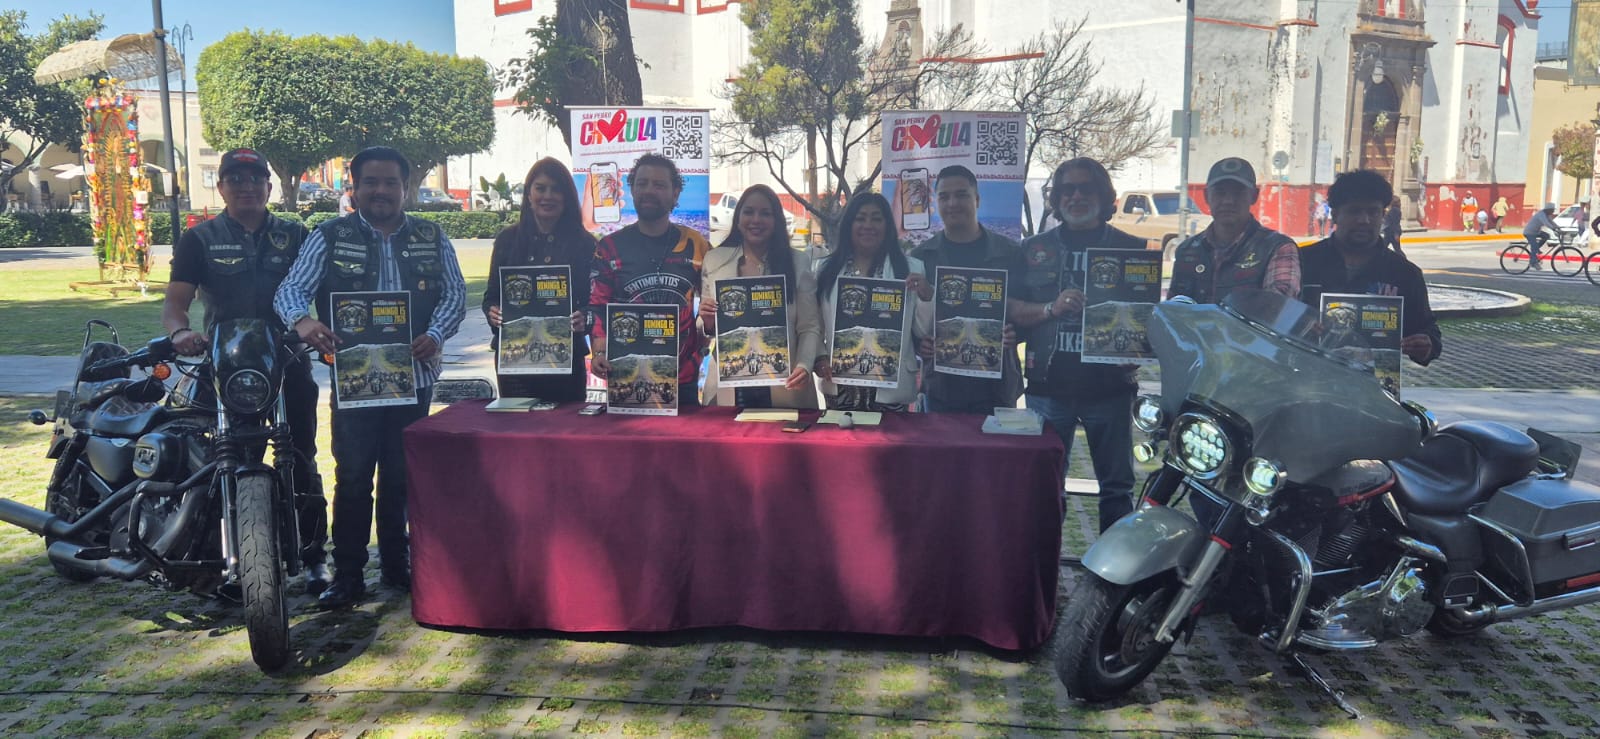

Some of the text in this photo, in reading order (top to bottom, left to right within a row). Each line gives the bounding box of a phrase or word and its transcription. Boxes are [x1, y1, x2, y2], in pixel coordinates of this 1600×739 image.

[580, 110, 657, 146] CHLULA
[891, 115, 972, 151] CHLULA
[624, 275, 680, 294] SENTIMIENTOS
